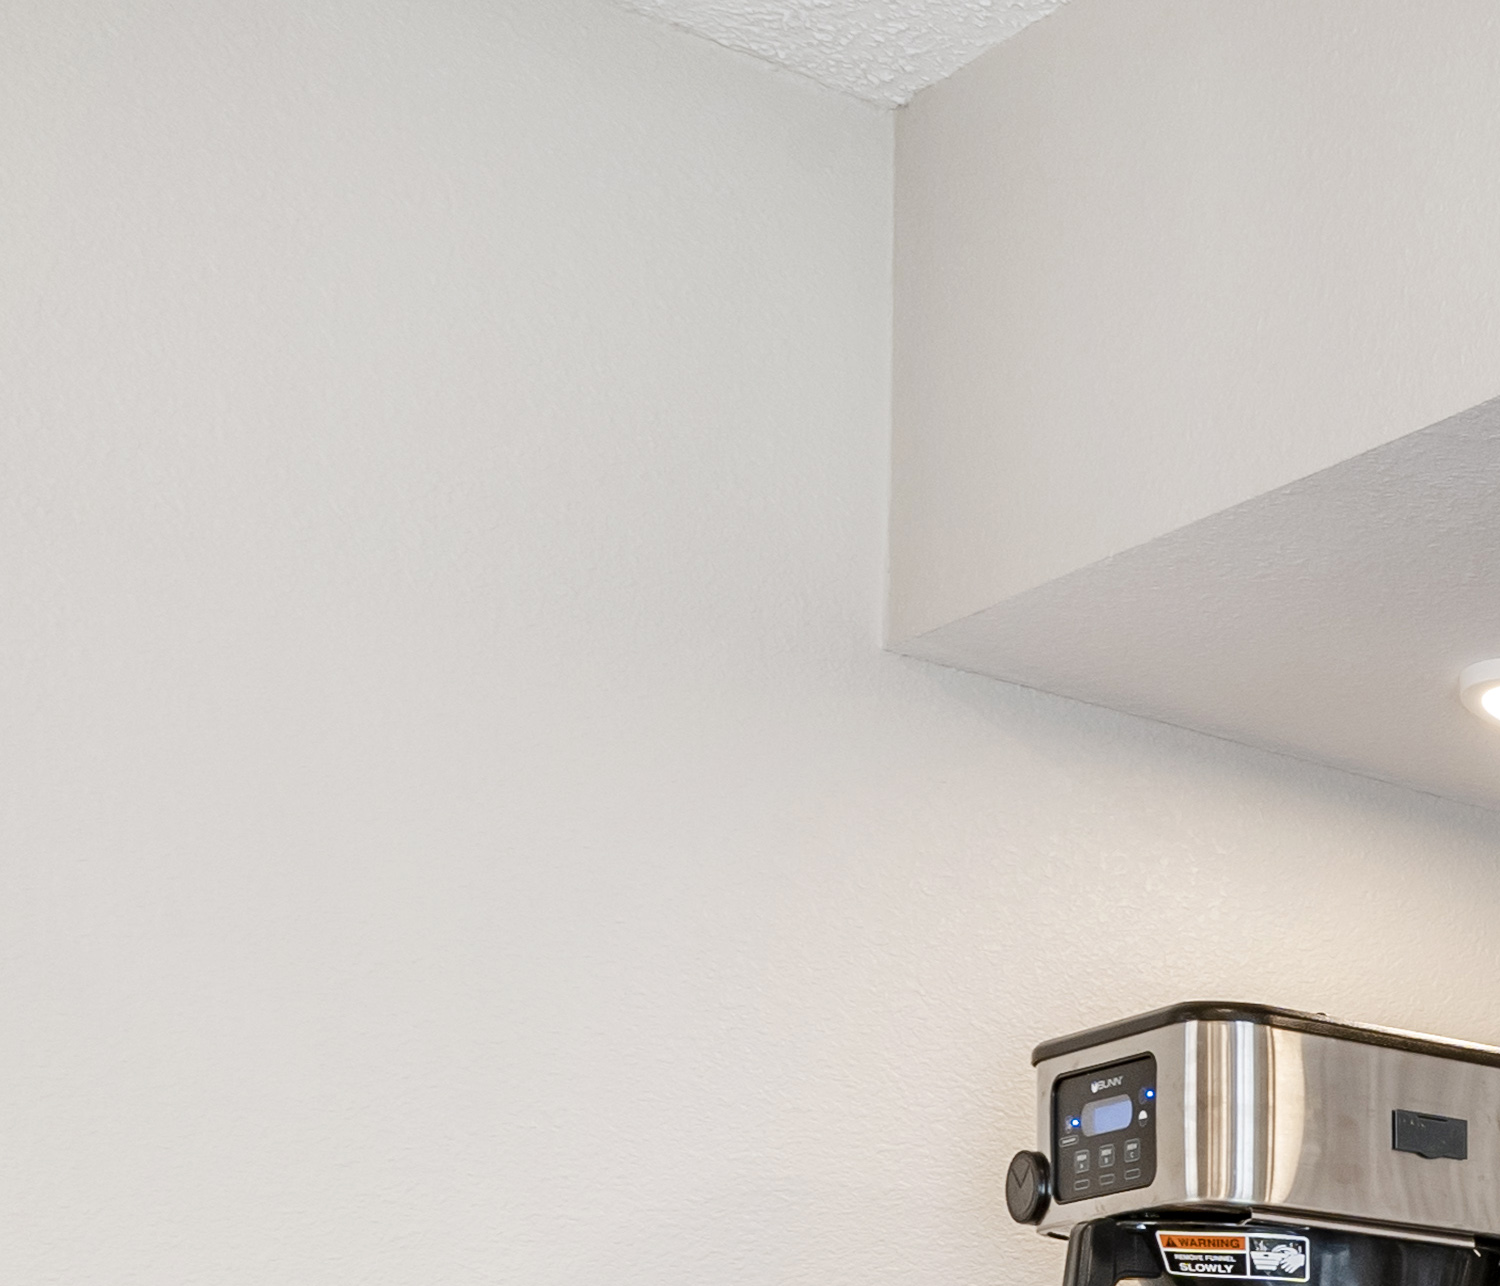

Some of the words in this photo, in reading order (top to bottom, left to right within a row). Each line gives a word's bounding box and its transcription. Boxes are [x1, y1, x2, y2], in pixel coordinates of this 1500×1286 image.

[1096, 1076, 1124, 1091] BUNN
[1178, 1236, 1240, 1249] WARNING
[1205, 1254, 1236, 1263] FUNNEL
[1178, 1262, 1234, 1274] SLOWLY
